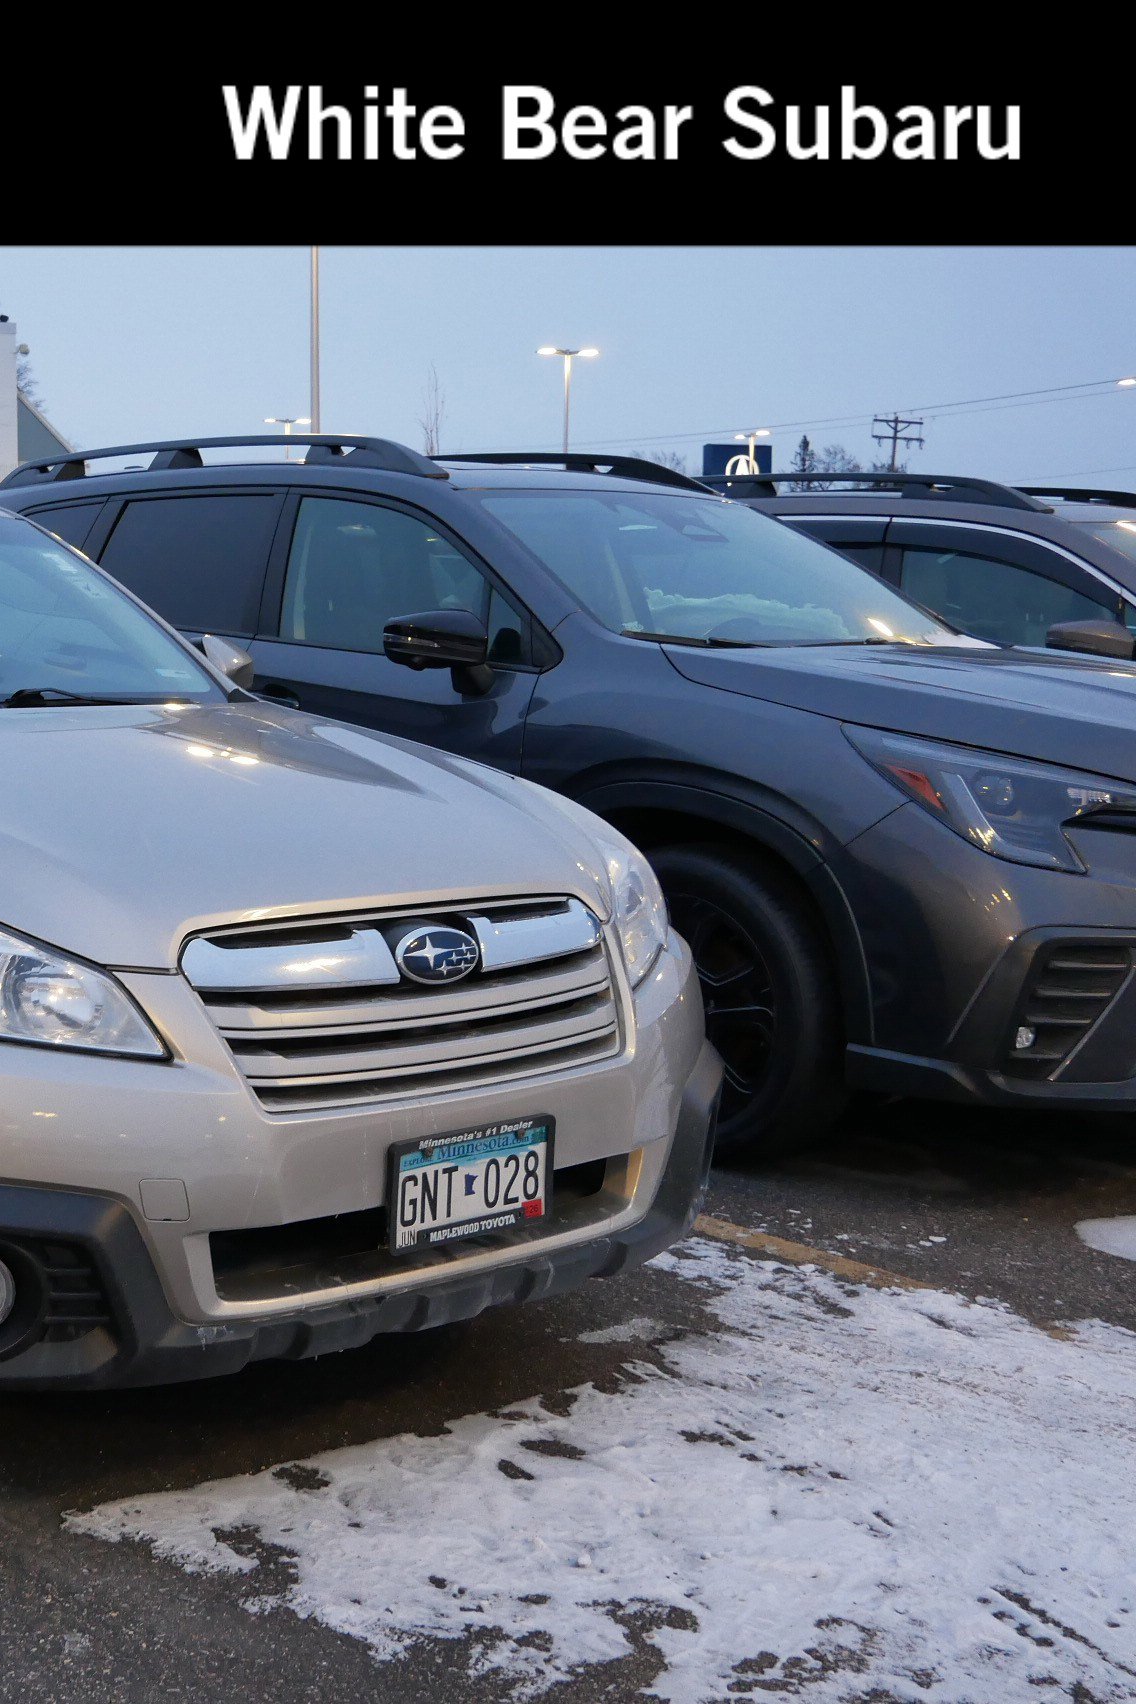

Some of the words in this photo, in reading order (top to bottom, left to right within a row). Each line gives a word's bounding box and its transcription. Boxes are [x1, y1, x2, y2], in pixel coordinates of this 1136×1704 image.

[418, 1130, 483, 1150] Minnesota's
[500, 1120, 533, 1134] Dealer
[400, 1165, 459, 1228] GNT
[483, 1150, 539, 1209] 028
[429, 1223, 480, 1242] MAPLEWOOD
[480, 1214, 516, 1231] TOYOTA
